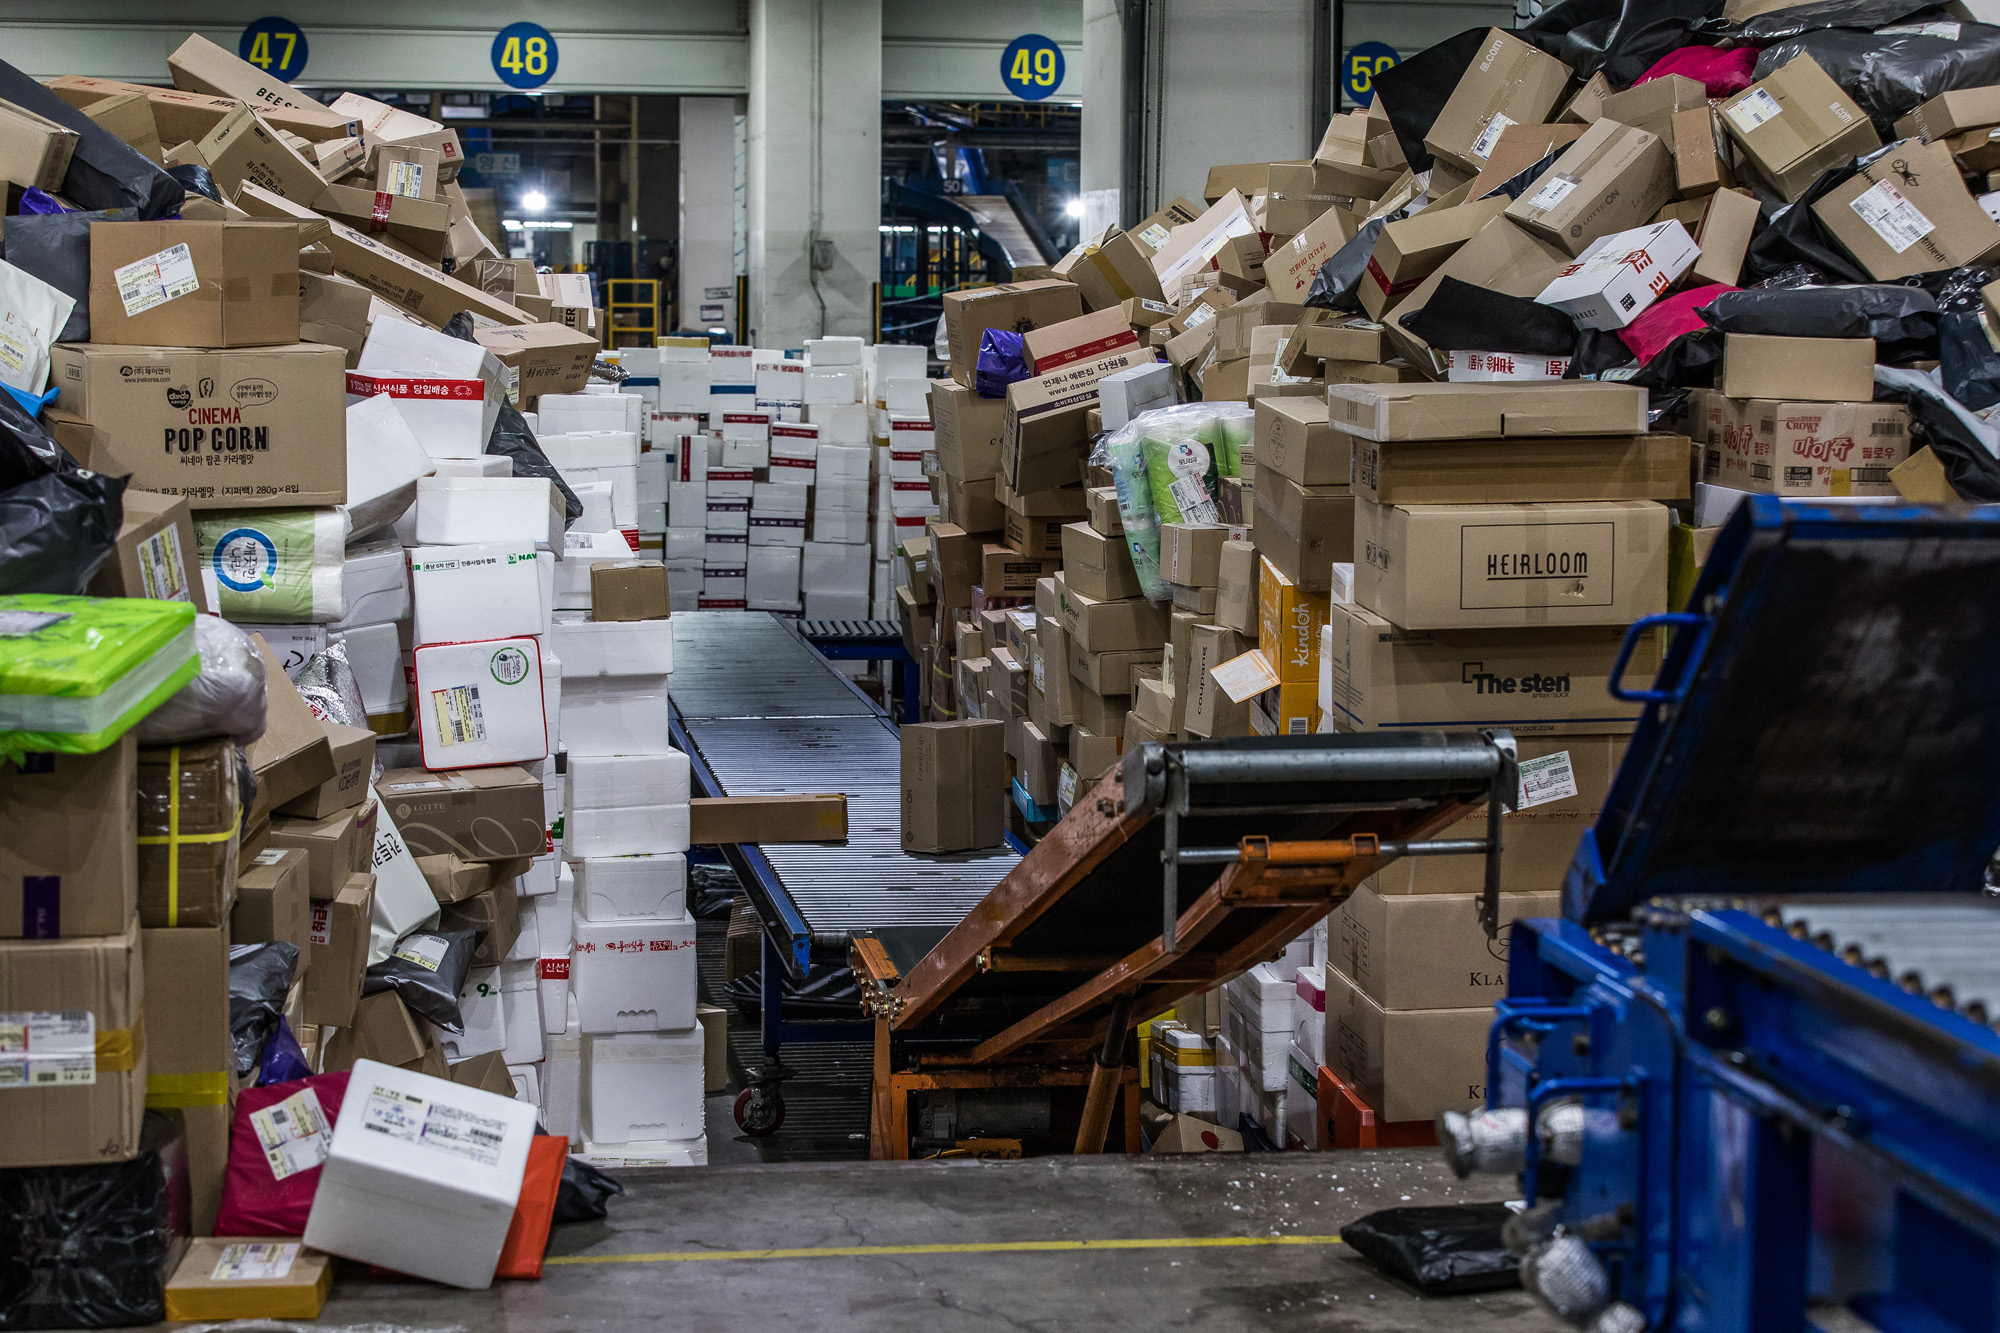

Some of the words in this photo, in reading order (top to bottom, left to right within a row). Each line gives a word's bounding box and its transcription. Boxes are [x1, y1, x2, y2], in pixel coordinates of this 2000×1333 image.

[249, 32, 297, 70] 47
[500, 36, 548, 74] 48
[1010, 48, 1055, 87] 49
[1604, 189, 1620, 205] ON
[1042, 376, 1068, 388] 언제나
[1069, 368, 1094, 381] 예쁜집
[1098, 357, 1129, 372] 다원몰
[372, 382, 408, 396] 신선식품
[413, 383, 450, 396] 당일배송
[189, 407, 242, 425] CINEMA
[164, 427, 204, 452] POP
[212, 425, 269, 451] CORN
[1723, 422, 1753, 456] 마이쮸
[1792, 436, 1855, 462] 마이쮸
[1861, 446, 1895, 460] 필로우
[180, 454, 203, 466] 씨네마
[205, 454, 221, 466] 팝콘
[223, 453, 254, 466] 카라멜맛
[181, 486, 215, 498] 카라멜맛
[221, 485, 254, 497] (지퍼백)
[1487, 551, 1588, 577] HEIRLOOM
[1291, 602, 1309, 667] kindoh
[1472, 673, 1517, 695] The
[1520, 672, 1570, 694] sten
[414, 803, 445, 814] LOTTE
[906, 789, 912, 804] ON
